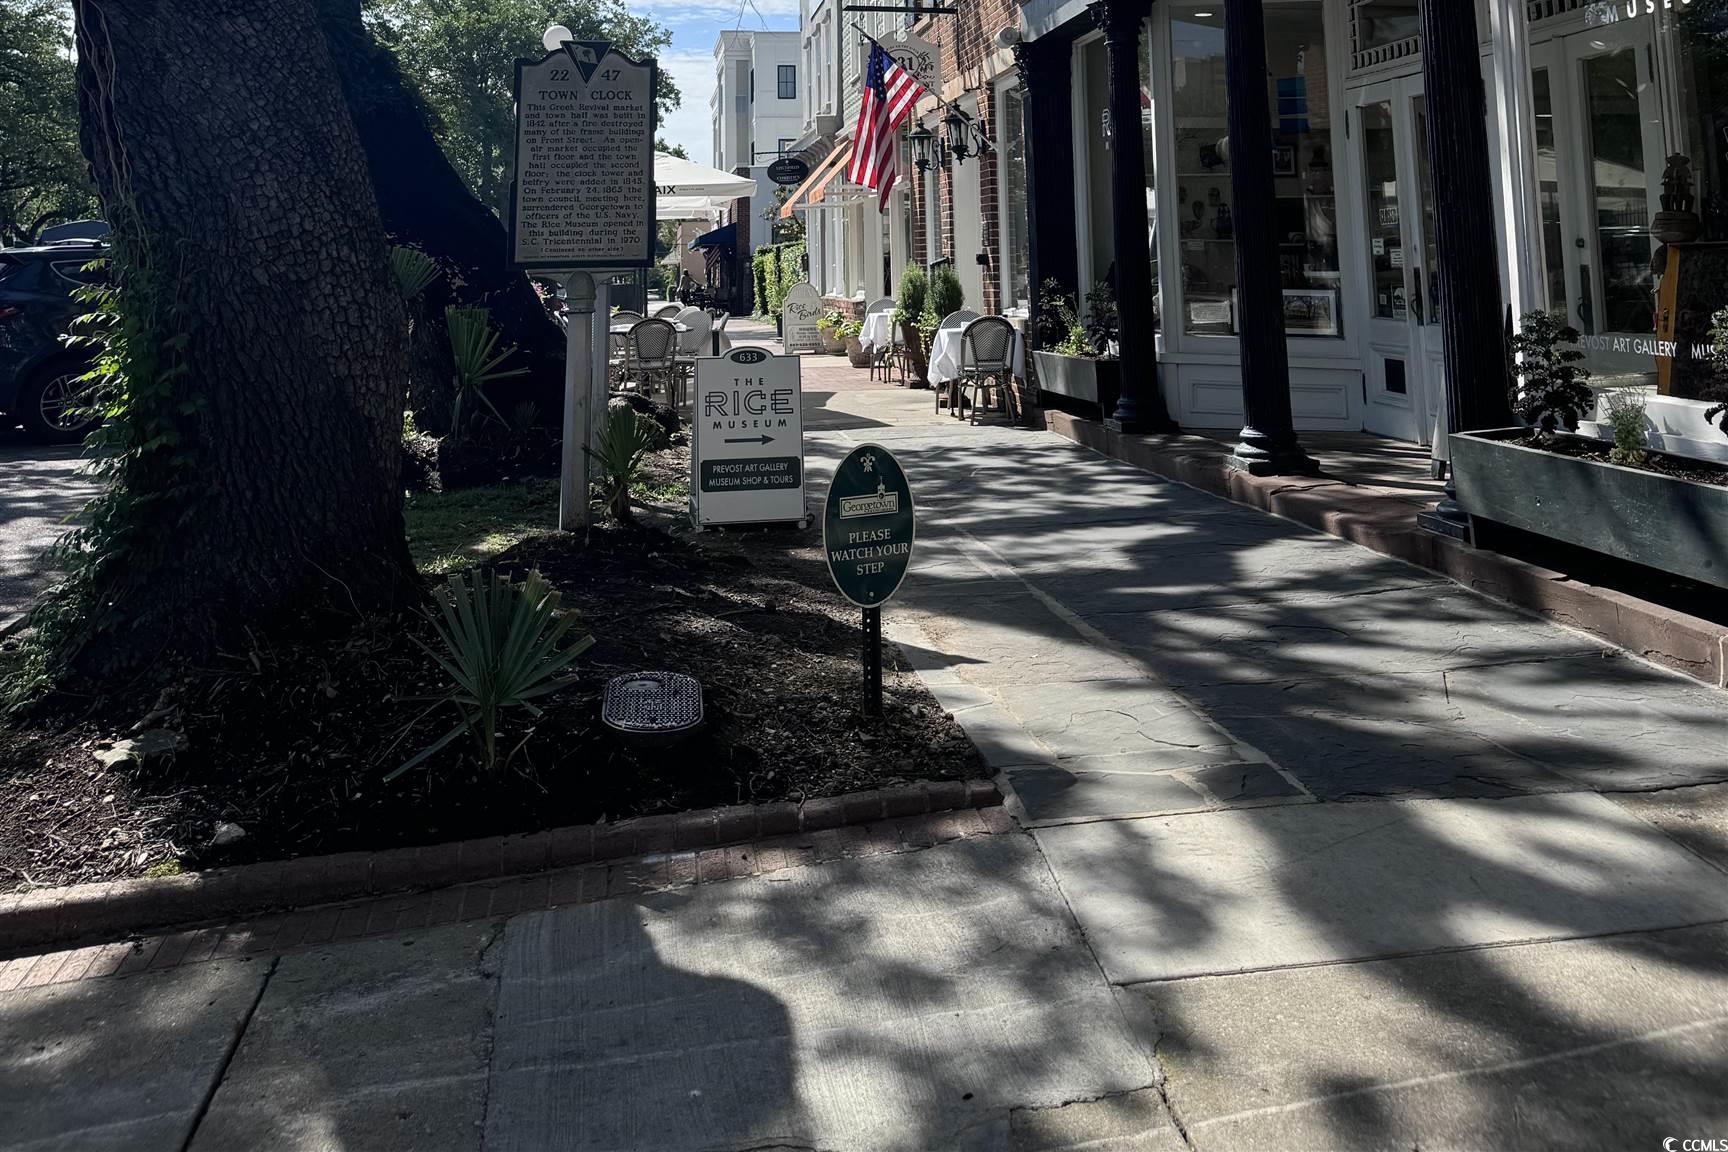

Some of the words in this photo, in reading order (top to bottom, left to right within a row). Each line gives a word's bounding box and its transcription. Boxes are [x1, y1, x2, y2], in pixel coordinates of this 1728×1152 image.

[550, 70, 569, 80] 22
[601, 70, 620, 80] 47
[539, 91, 578, 100] TOWN
[591, 90, 632, 100] CLOCK
[601, 120, 643, 128] destroyed
[586, 195, 618, 203] meeting
[579, 203, 630, 211] Georgetown
[526, 212, 559, 220] officers
[589, 229, 617, 237] during
[787, 302, 806, 314] Rice
[798, 307, 820, 320] Birds
[1613, 338, 1630, 352] ART
[1634, 339, 1677, 358] GALLERY
[740, 353, 758, 361] 633
[734, 378, 764, 386] THE
[705, 389, 793, 416] RICE
[713, 419, 787, 429] MUSEUM
[713, 464, 743, 474] PREVOST
[745, 464, 758, 472] ART
[759, 462, 788, 472] GALLERY
[709, 477, 740, 487] MUSEUM
[742, 476, 762, 485] SHOP
[763, 476, 768, 484] &
[770, 474, 793, 484] TOURS
[843, 501, 894, 512] Georgetown
[849, 529, 891, 544] PLEASE
[831, 547, 873, 562] WATCH
[876, 542, 908, 557] YOUR
[857, 562, 884, 575] STEP
